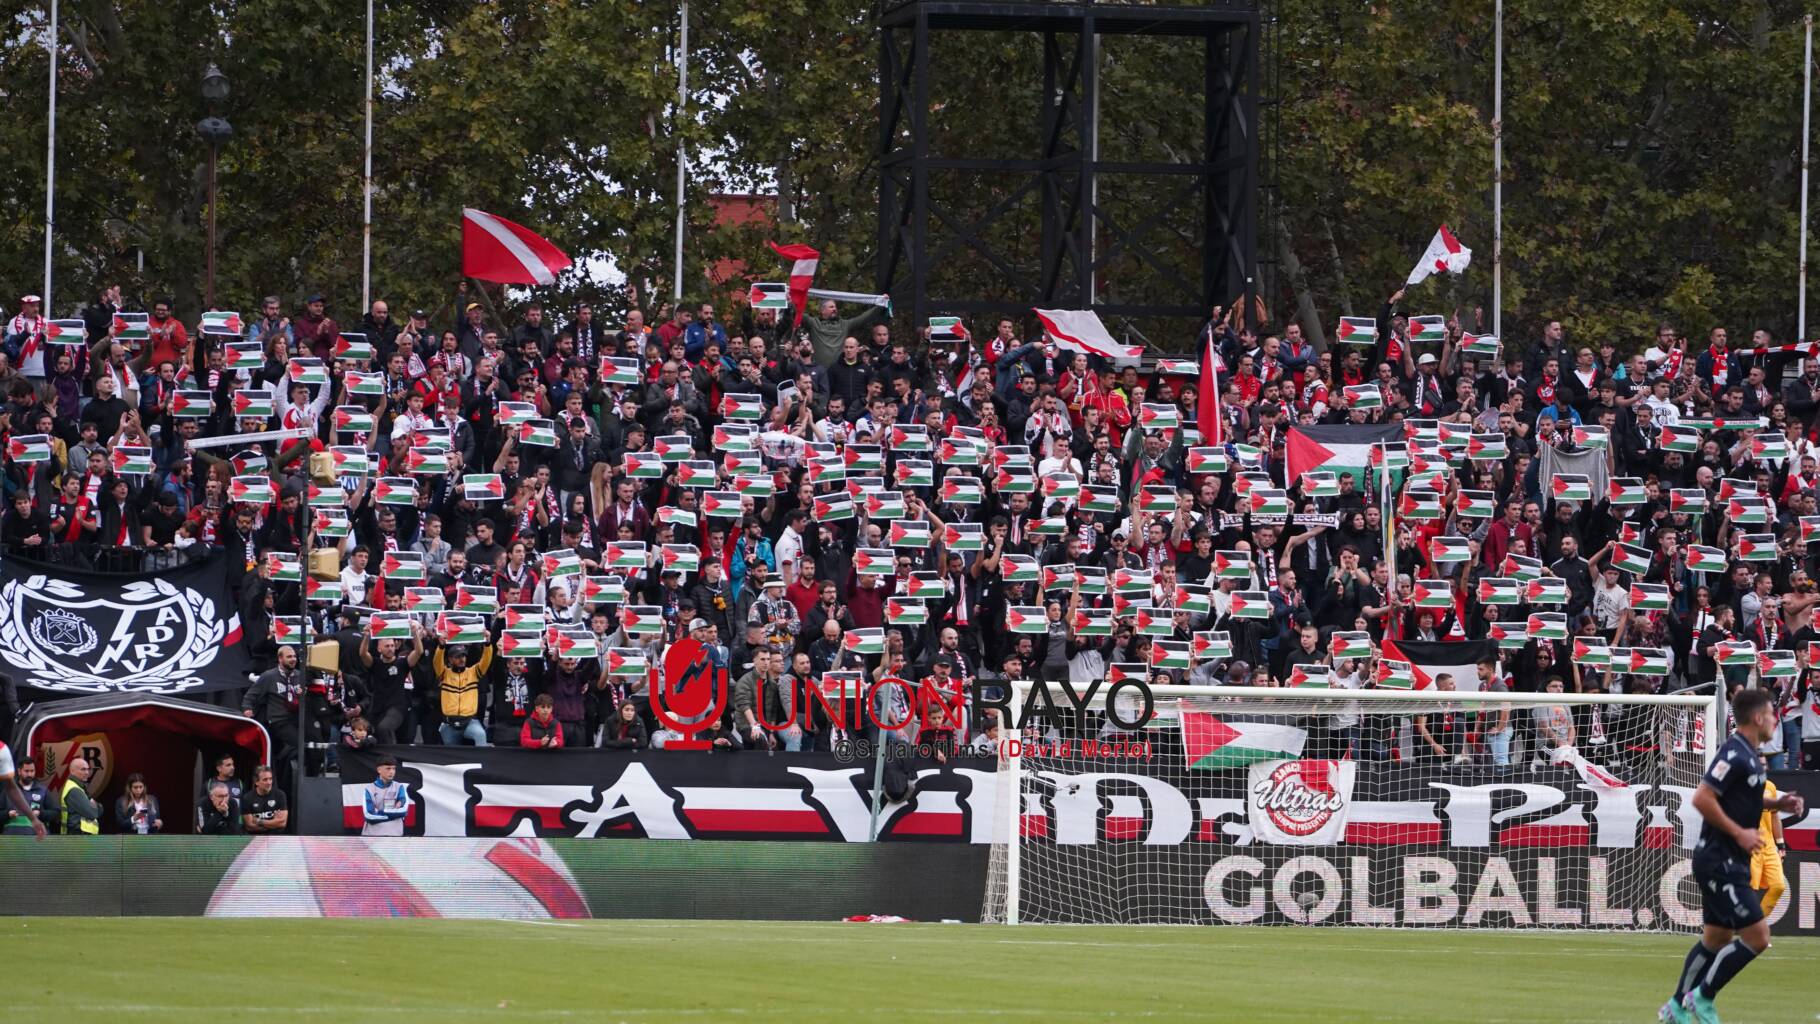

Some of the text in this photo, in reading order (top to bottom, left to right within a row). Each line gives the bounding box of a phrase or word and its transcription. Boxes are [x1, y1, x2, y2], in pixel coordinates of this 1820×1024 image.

[787, 767, 1252, 845] VID
[1254, 779, 1343, 812] Ultras
[1722, 883, 1739, 906] 7
